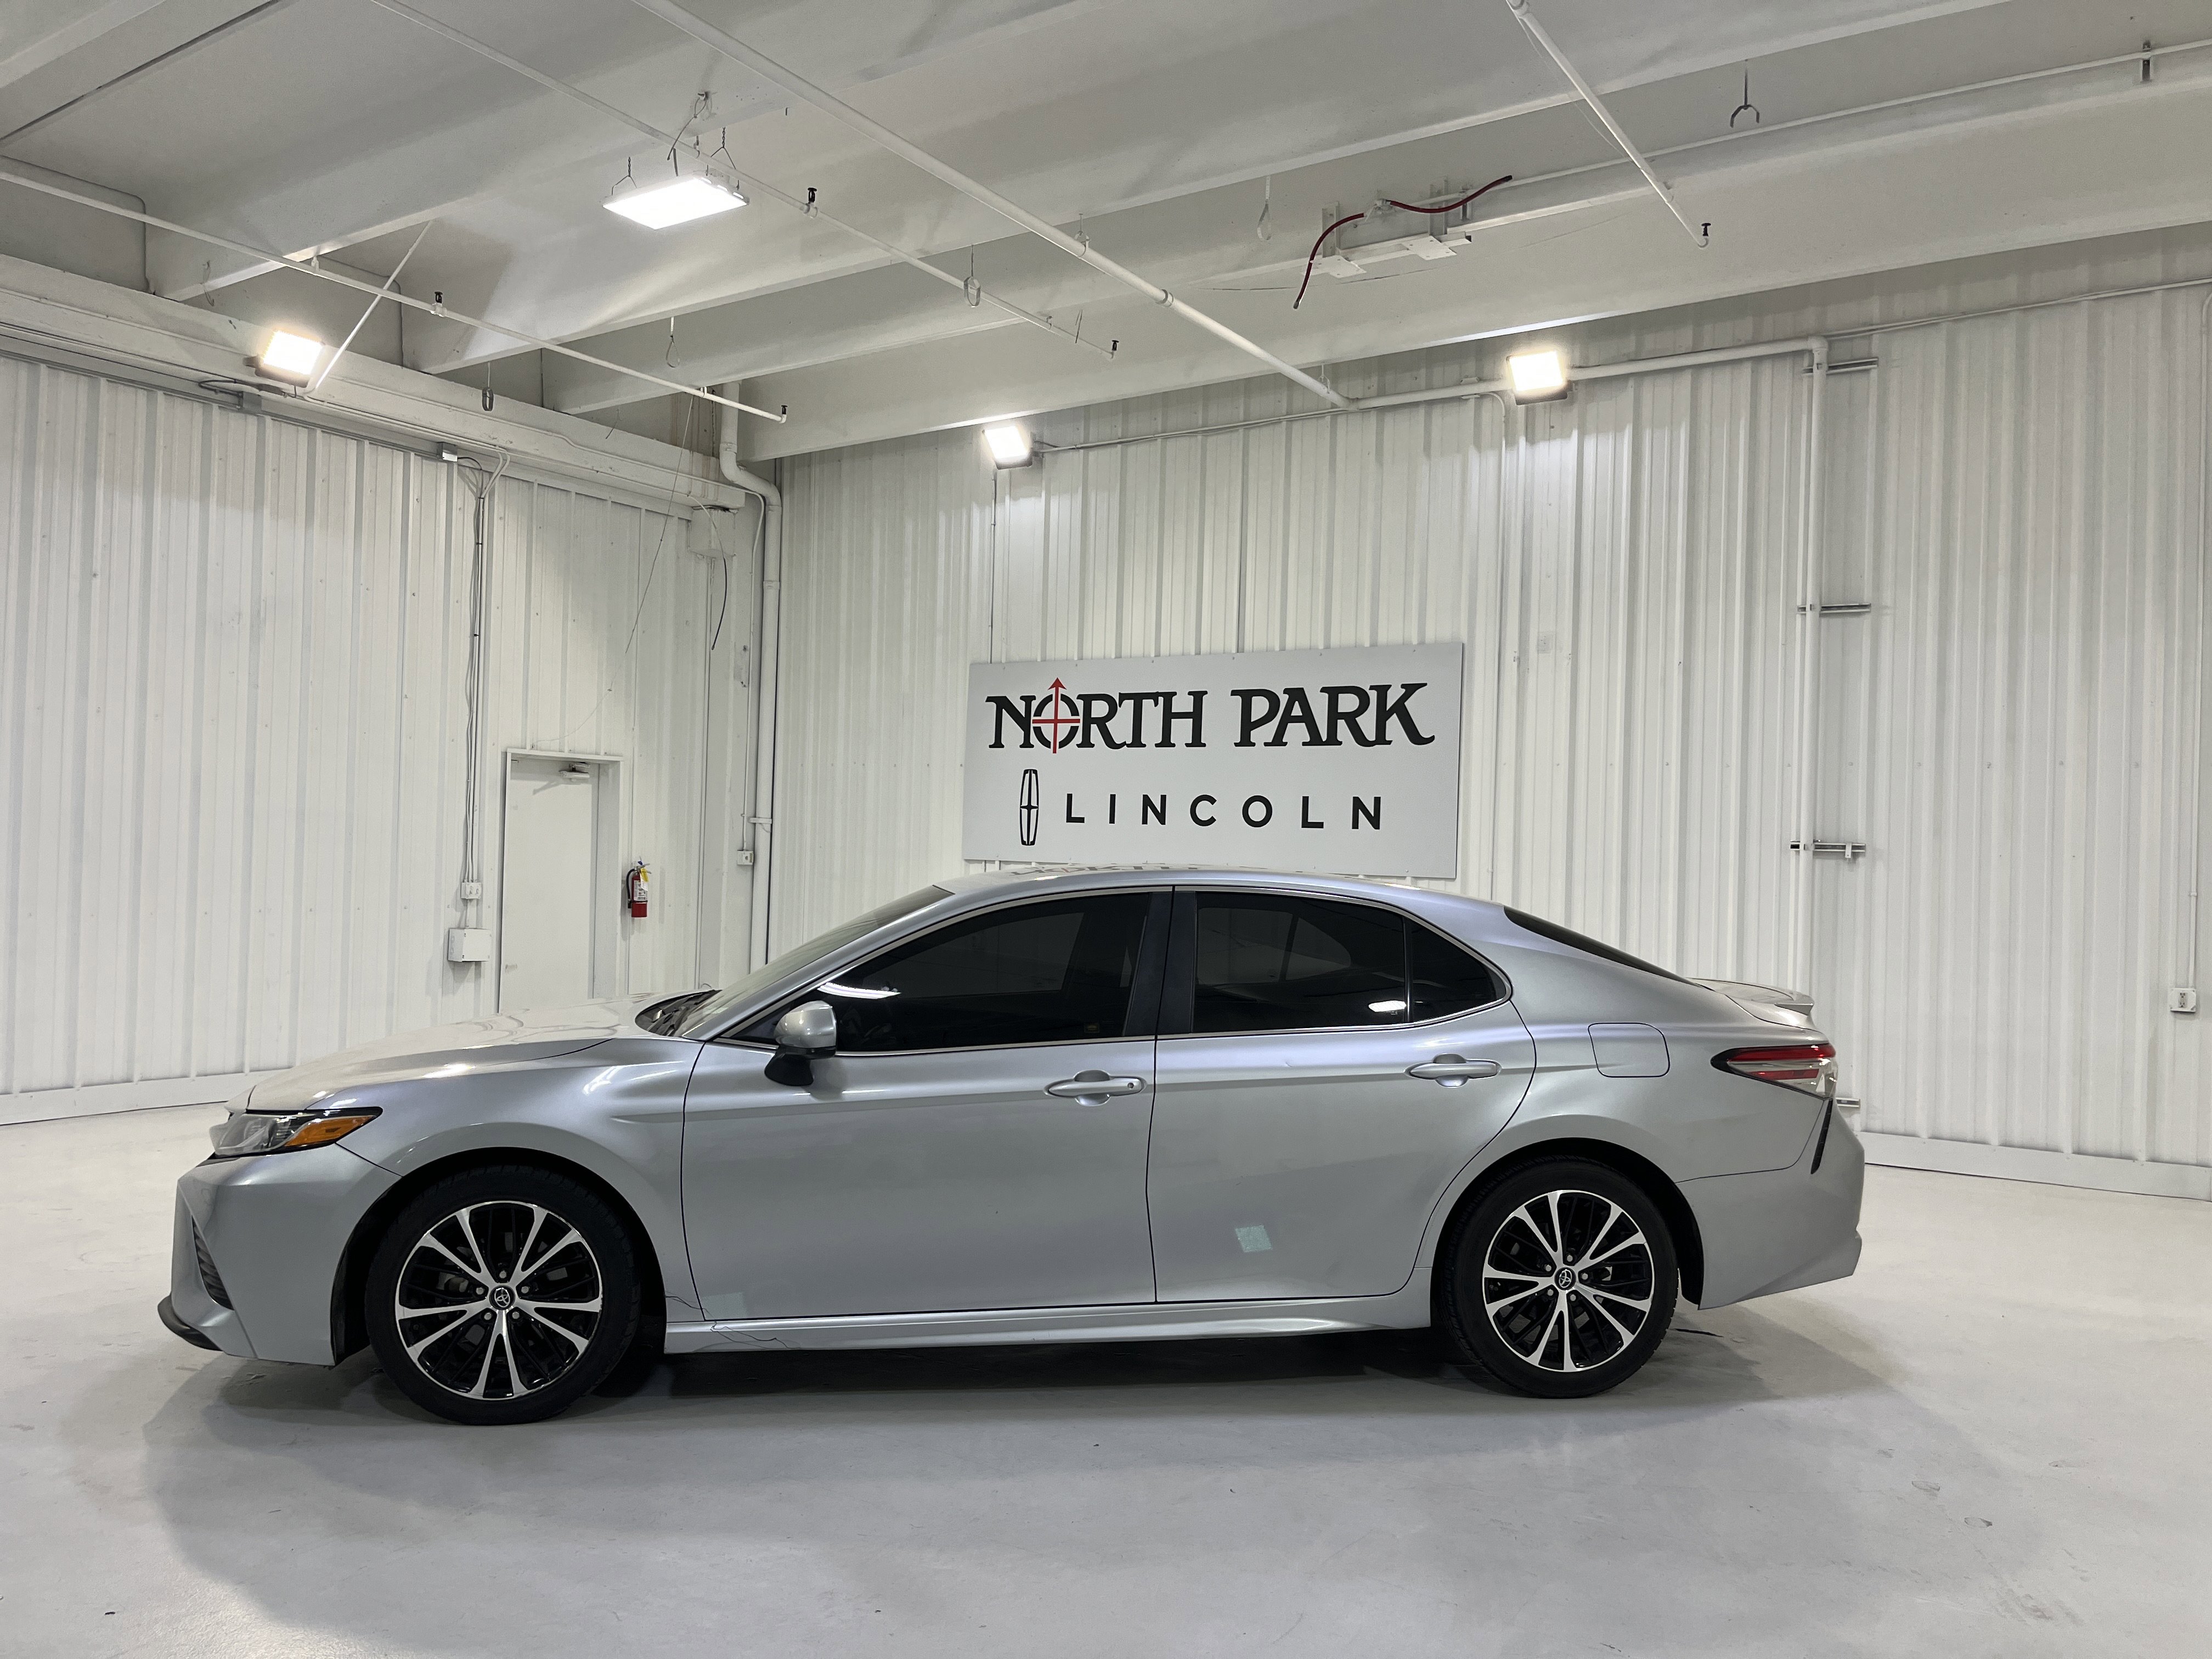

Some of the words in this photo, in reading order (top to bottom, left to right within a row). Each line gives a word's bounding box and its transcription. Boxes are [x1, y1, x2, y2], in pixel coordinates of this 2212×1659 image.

[985, 689, 1208, 751] NORTH
[1230, 682, 1435, 748] PARK
[1065, 793, 1381, 830] LINCOLN
